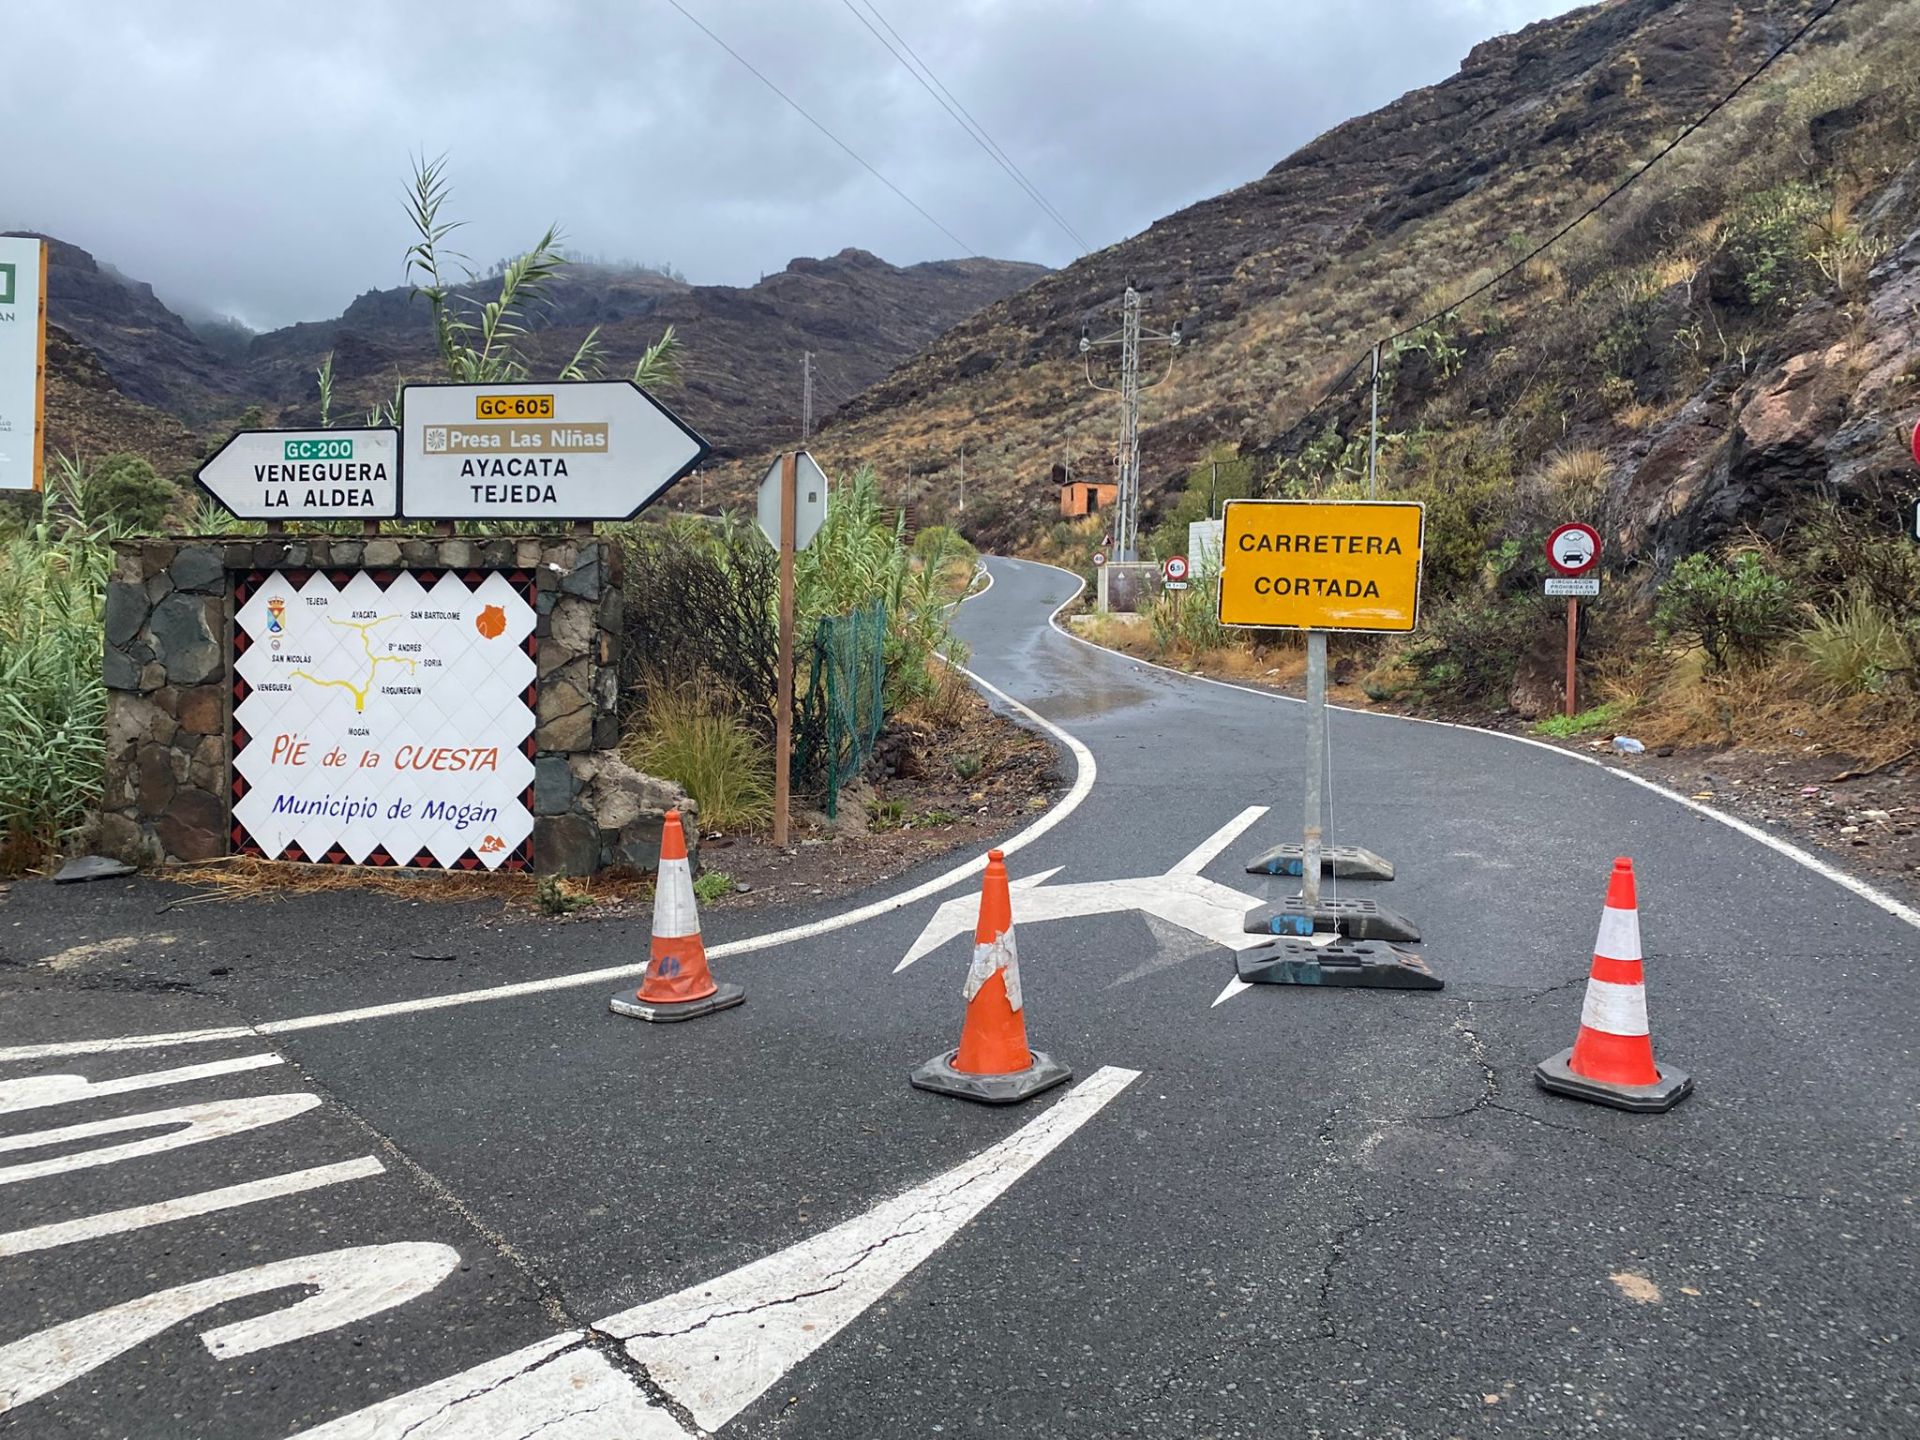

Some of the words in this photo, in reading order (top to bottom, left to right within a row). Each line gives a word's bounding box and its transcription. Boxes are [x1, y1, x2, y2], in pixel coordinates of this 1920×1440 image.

[480, 400, 550, 415] GC-605
[450, 431, 501, 448] Presa
[510, 430, 542, 447] Las
[551, 429, 606, 447] Niñas
[286, 441, 352, 458] GC-200
[254, 463, 387, 482] VENEGUERA
[461, 458, 568, 477] AYACATA
[265, 490, 289, 507] LA
[303, 489, 374, 507] ALDEA
[470, 485, 557, 503] TEJEDA
[1239, 533, 1402, 555] CARRETERA
[1254, 576, 1380, 598] CORTADA
[305, 597, 328, 606] TEJEDA
[351, 610, 378, 619] AYACATA
[410, 611, 423, 619] SAN
[272, 654, 285, 662] SAN
[423, 659, 442, 667] SORIA
[257, 683, 292, 692] VENEGUERA
[322, 746, 347, 767] de
[359, 750, 380, 768] la
[394, 745, 498, 772] CUESTA
[272, 794, 378, 825] Municipio
[387, 797, 412, 819] de
[421, 801, 498, 830] Mogán
